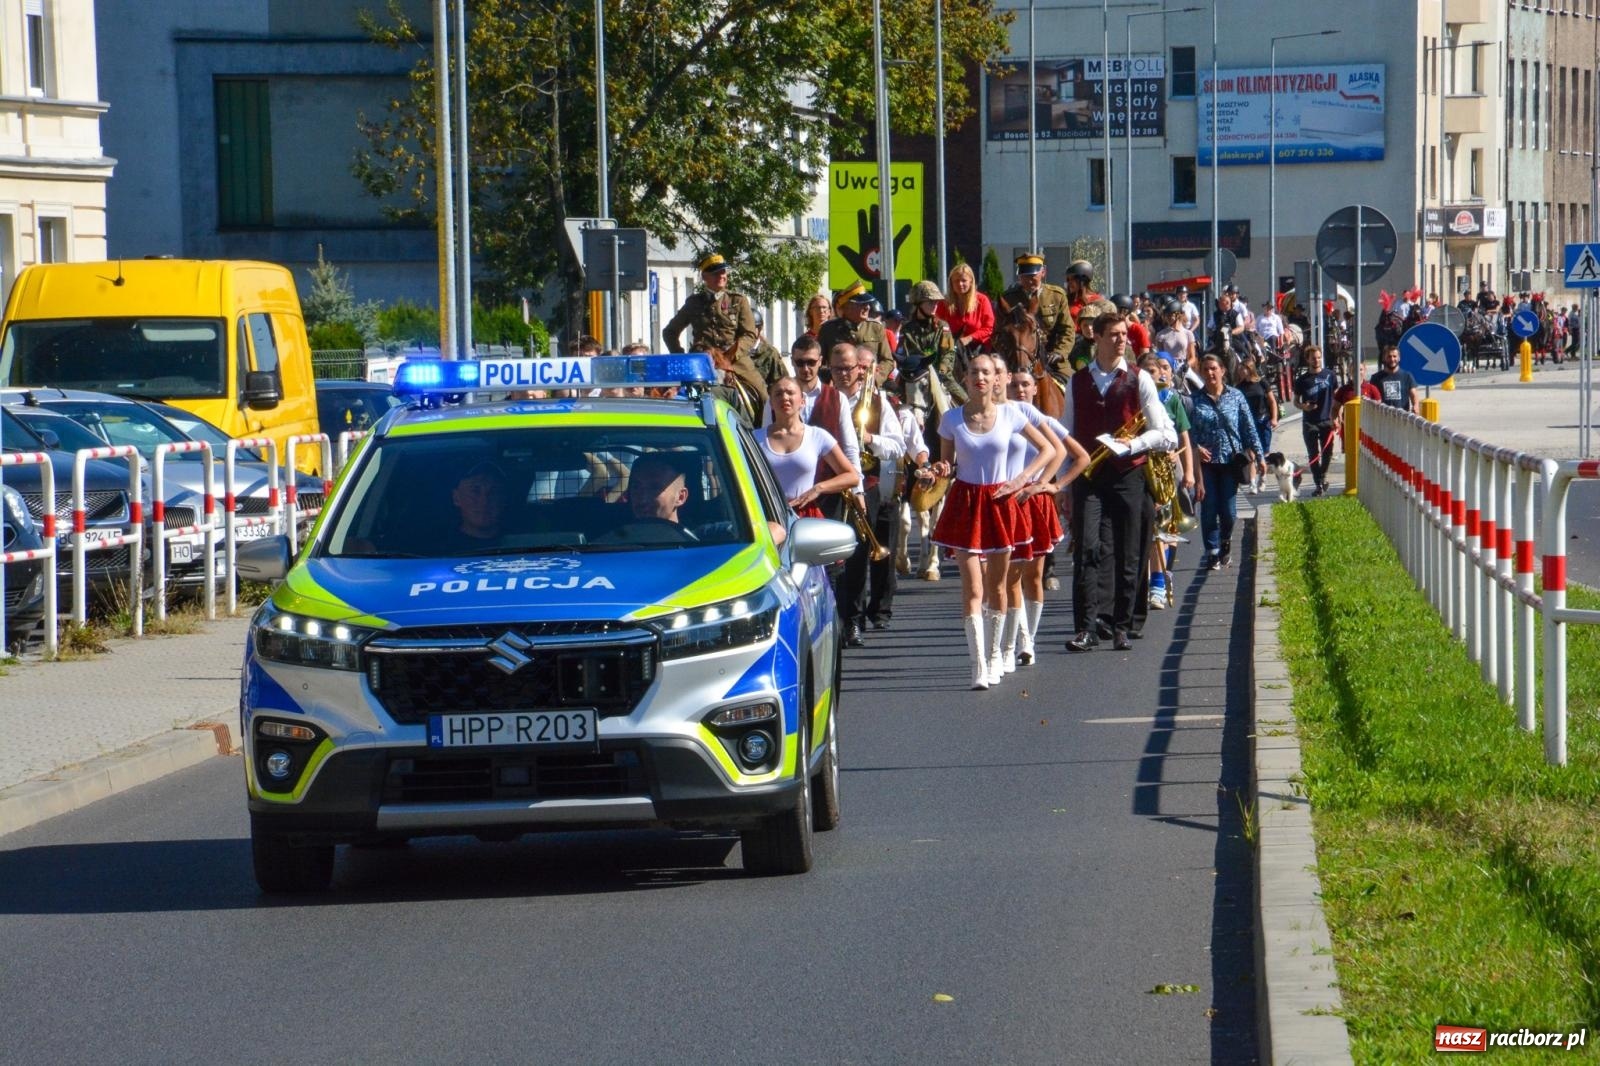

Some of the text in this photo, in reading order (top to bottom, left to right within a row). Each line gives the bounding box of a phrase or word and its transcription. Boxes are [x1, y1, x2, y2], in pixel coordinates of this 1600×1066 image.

[1236, 73, 1337, 95] KLIMATYZACJI
[1348, 71, 1380, 84] ALASKA
[1092, 111, 1158, 124] Wnęrza
[835, 170, 915, 195] Uwaga
[485, 361, 585, 386] POLICJA
[409, 576, 616, 597] POLICJA
[431, 713, 587, 744] PL HPP R203
